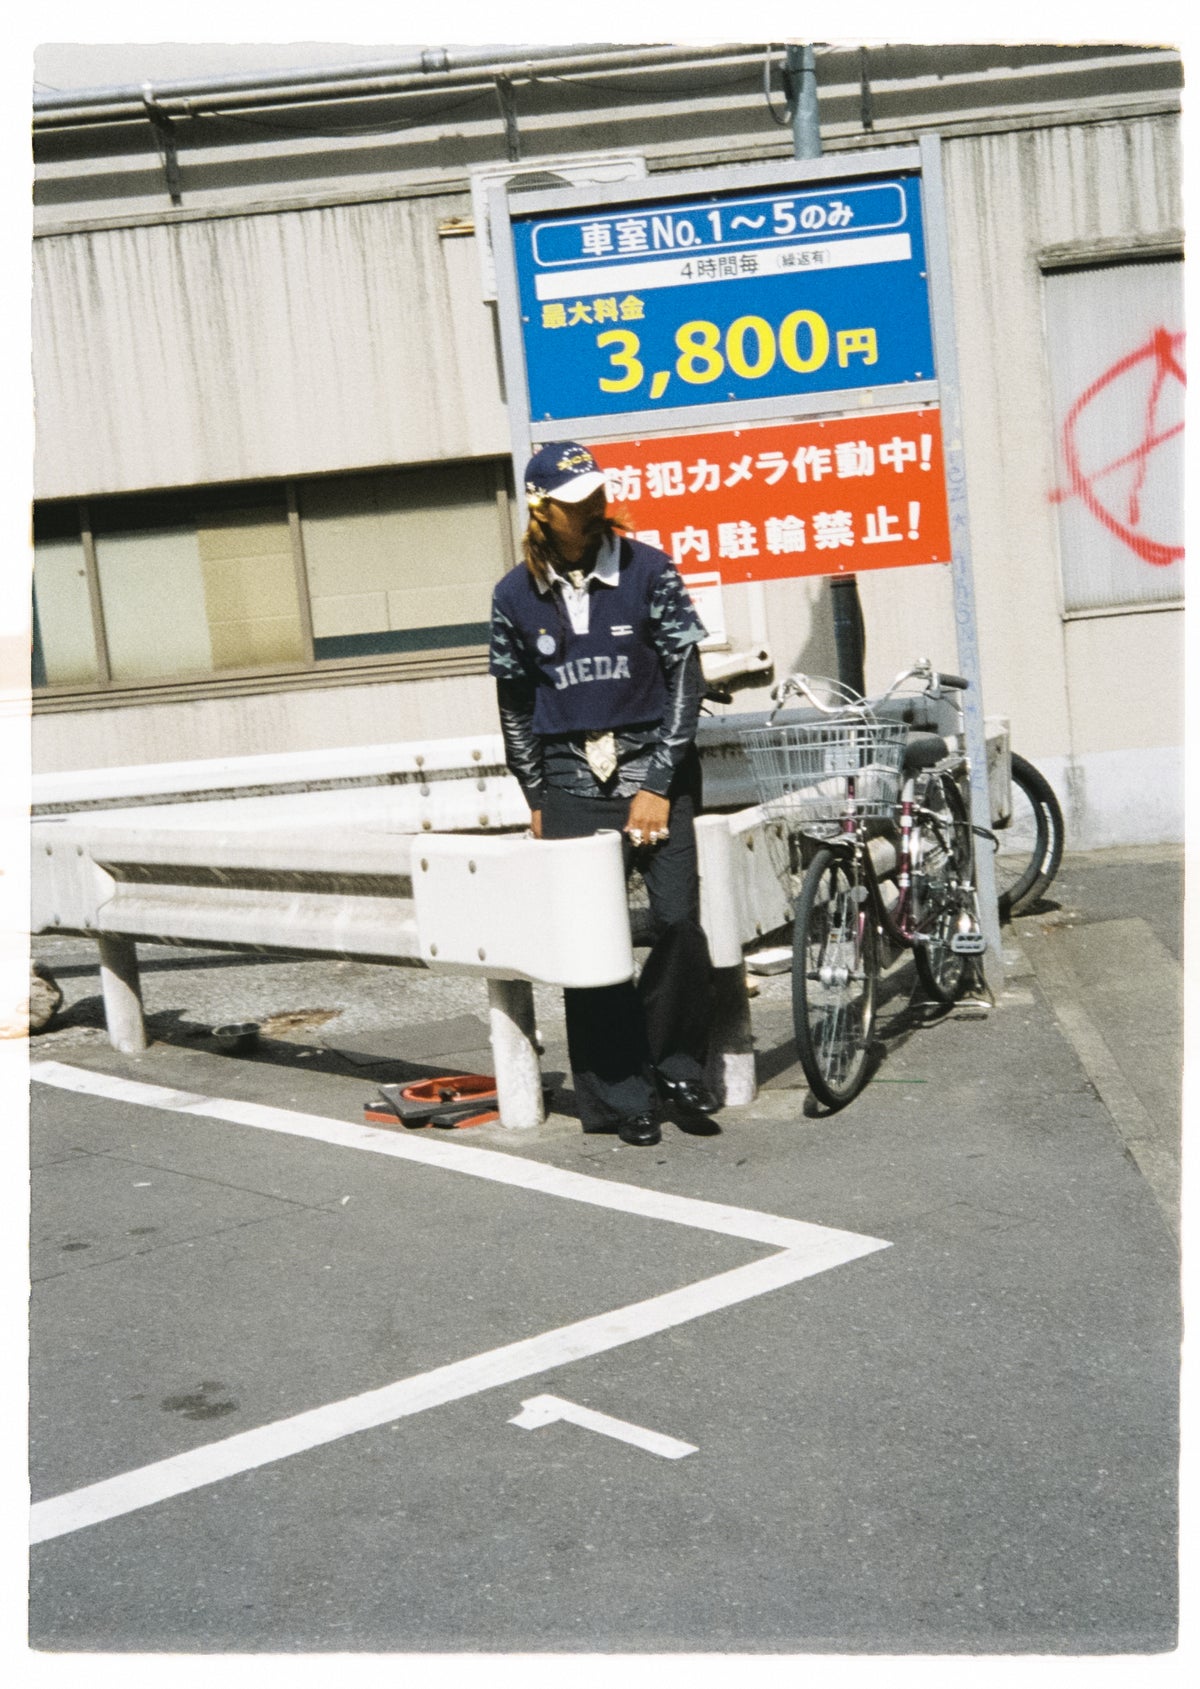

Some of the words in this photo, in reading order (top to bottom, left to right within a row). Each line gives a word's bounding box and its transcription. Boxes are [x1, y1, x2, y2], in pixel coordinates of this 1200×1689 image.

[680, 253, 759, 280] 4時間毎
[541, 294, 646, 329] 最大料金
[597, 309, 879, 400] 3,800円
[602, 433, 933, 504] 防犯カメラ作動中!
[554, 655, 631, 690] JIEDA
